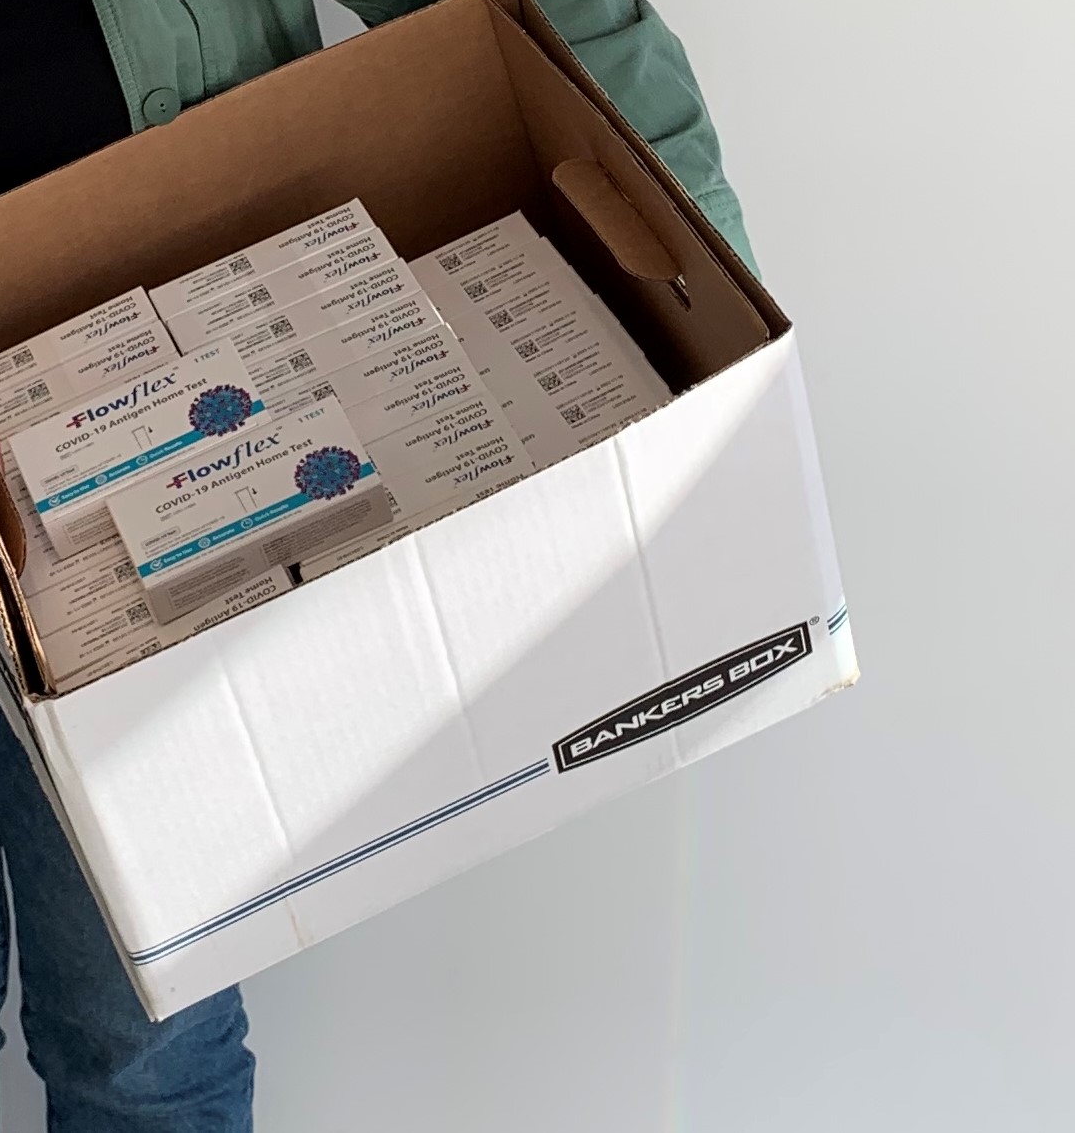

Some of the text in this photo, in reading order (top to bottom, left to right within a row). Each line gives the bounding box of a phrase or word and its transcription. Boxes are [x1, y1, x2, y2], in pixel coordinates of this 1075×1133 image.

[278, 213, 355, 249] COVID-19 Antigen
[307, 207, 351, 230] Home Test
[304, 222, 360, 249] Flowflex
[328, 237, 372, 258] Home Test
[298, 243, 376, 279] COVID-19 Antigen
[324, 252, 381, 279] Flowflex
[321, 274, 399, 310] COVID-19 Antigen
[349, 268, 395, 290] Home Test
[89, 295, 133, 319] Home Test
[347, 282, 405, 311] Flowflex
[60, 303, 136, 341] COVID-19 Antigen
[85, 312, 141, 341] Flowflex
[341, 307, 420, 344] COVID-19 Antigen
[371, 300, 416, 324] Home Test
[108, 329, 152, 353] Home Test
[368, 317, 426, 345] Flowflex
[393, 333, 439, 357] Home Test
[103, 346, 160, 375] Flowflex
[113, 335, 156, 361] COVID-19
[201, 348, 221, 361] TEST
[363, 340, 444, 377] COVID-19 Antigen
[78, 357, 112, 374] Antigen
[391, 349, 449, 378] Flowflex
[434, 367, 461, 381] Home
[384, 373, 466, 412] COVID-19 Antigen
[412, 383, 471, 412] Flowflex
[414, 376, 434, 390] Test
[55, 424, 107, 453] COVID-19
[109, 404, 152, 429] Antigen
[152, 390, 183, 408] Home
[184, 377, 208, 393] Test
[66, 372, 176, 429] Flowflex
[304, 408, 325, 421] TEST
[435, 401, 483, 424] Home Test
[405, 408, 488, 447] COVID-19 Antigen
[433, 418, 494, 446] Flowflex
[456, 446, 475, 460] Test
[476, 436, 504, 451] Home
[166, 433, 281, 489] Flowflex
[425, 443, 508, 483] COVID-19 Antigen
[454, 453, 515, 483] Flowflex
[155, 484, 209, 515] COVID-19
[211, 465, 255, 489] Antigen
[256, 449, 289, 469] Home
[289, 438, 313, 453] Test
[225, 576, 273, 605] Home Test
[231, 585, 277, 614] COVID-19
[193, 609, 230, 632] Antigen
[570, 637, 798, 759] BANKERS BOX
